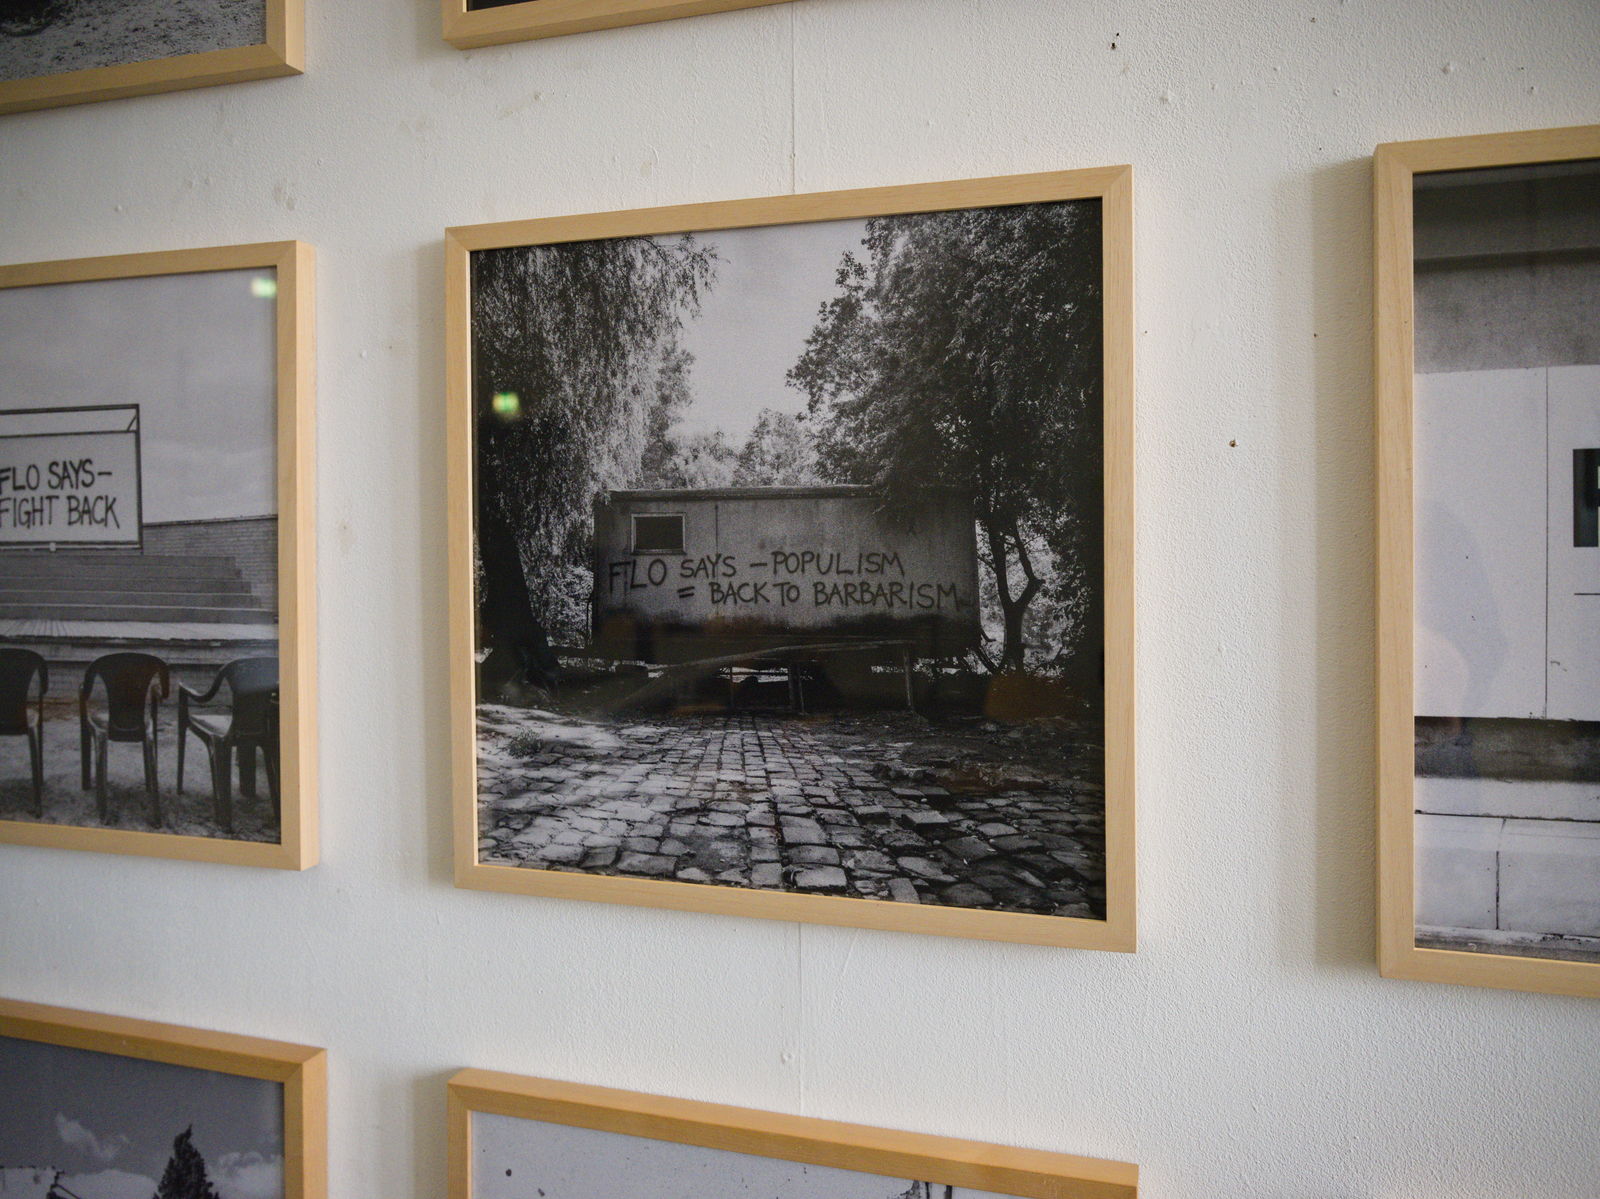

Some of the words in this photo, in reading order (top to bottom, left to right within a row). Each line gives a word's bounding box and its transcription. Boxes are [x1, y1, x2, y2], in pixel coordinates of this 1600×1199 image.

[0, 464, 40, 494] FLO
[0, 495, 60, 529] FIGHT
[66, 494, 120, 529] BACK
[609, 559, 667, 594] FLO
[679, 553, 737, 578] SAYS
[708, 581, 770, 604] BACK
[771, 582, 801, 607] TO
[813, 581, 961, 610] BARBARISM
